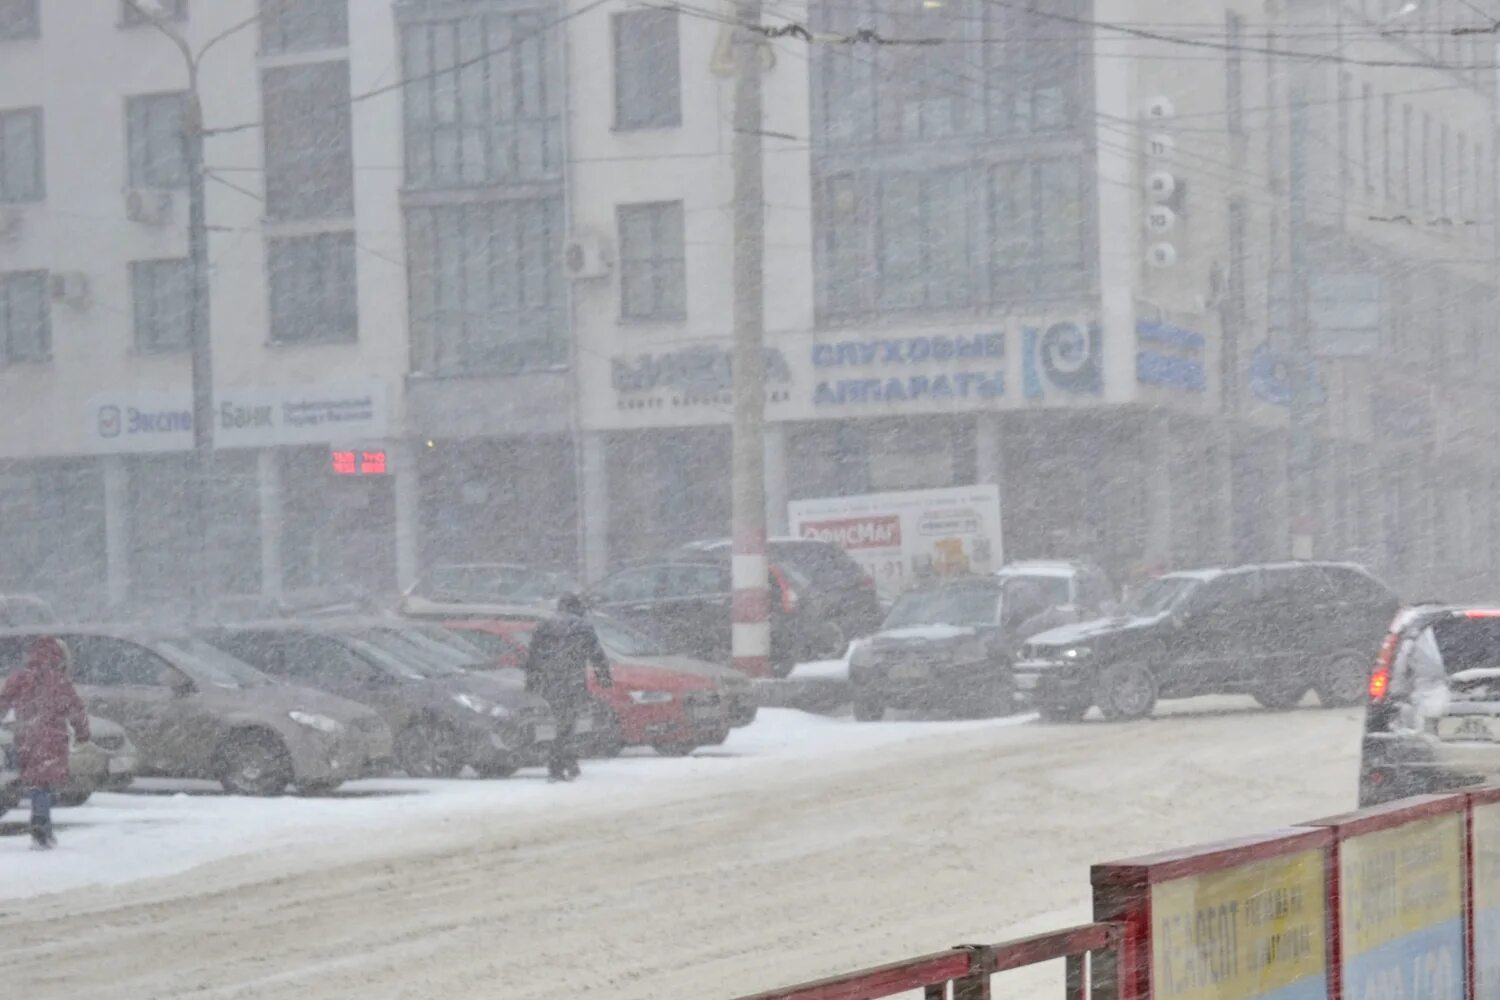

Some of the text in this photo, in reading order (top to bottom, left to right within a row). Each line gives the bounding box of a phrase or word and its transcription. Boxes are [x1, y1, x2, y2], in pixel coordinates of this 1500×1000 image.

[813, 333, 1005, 367] СЛУХОВЫЕ
[813, 371, 1005, 405] АППАРАТЫ
[219, 401, 274, 429] Банк
